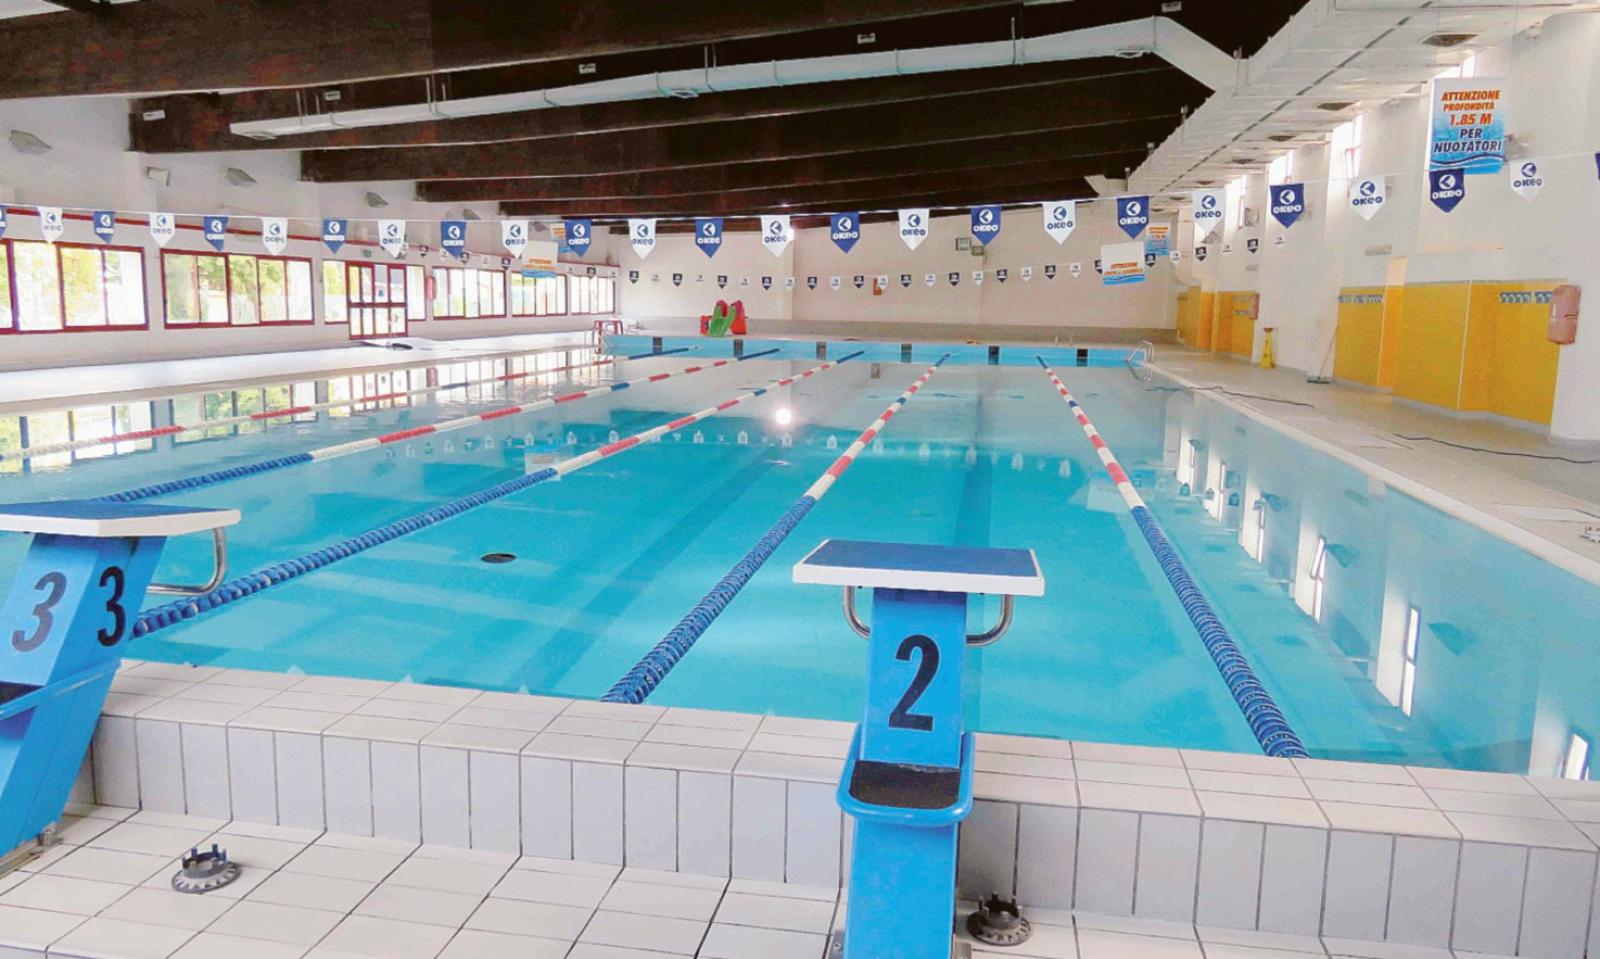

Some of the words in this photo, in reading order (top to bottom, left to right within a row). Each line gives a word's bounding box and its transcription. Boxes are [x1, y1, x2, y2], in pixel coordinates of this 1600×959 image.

[1441, 90, 1500, 101] ATTENZIONE
[1450, 113, 1476, 127] 1.85
[1480, 113, 1492, 125] M
[1460, 128, 1483, 138] PER
[1434, 141, 1502, 152] NUOTATORI
[12, 571, 67, 652] 3
[97, 566, 126, 647] 3
[888, 634, 940, 732] 2
